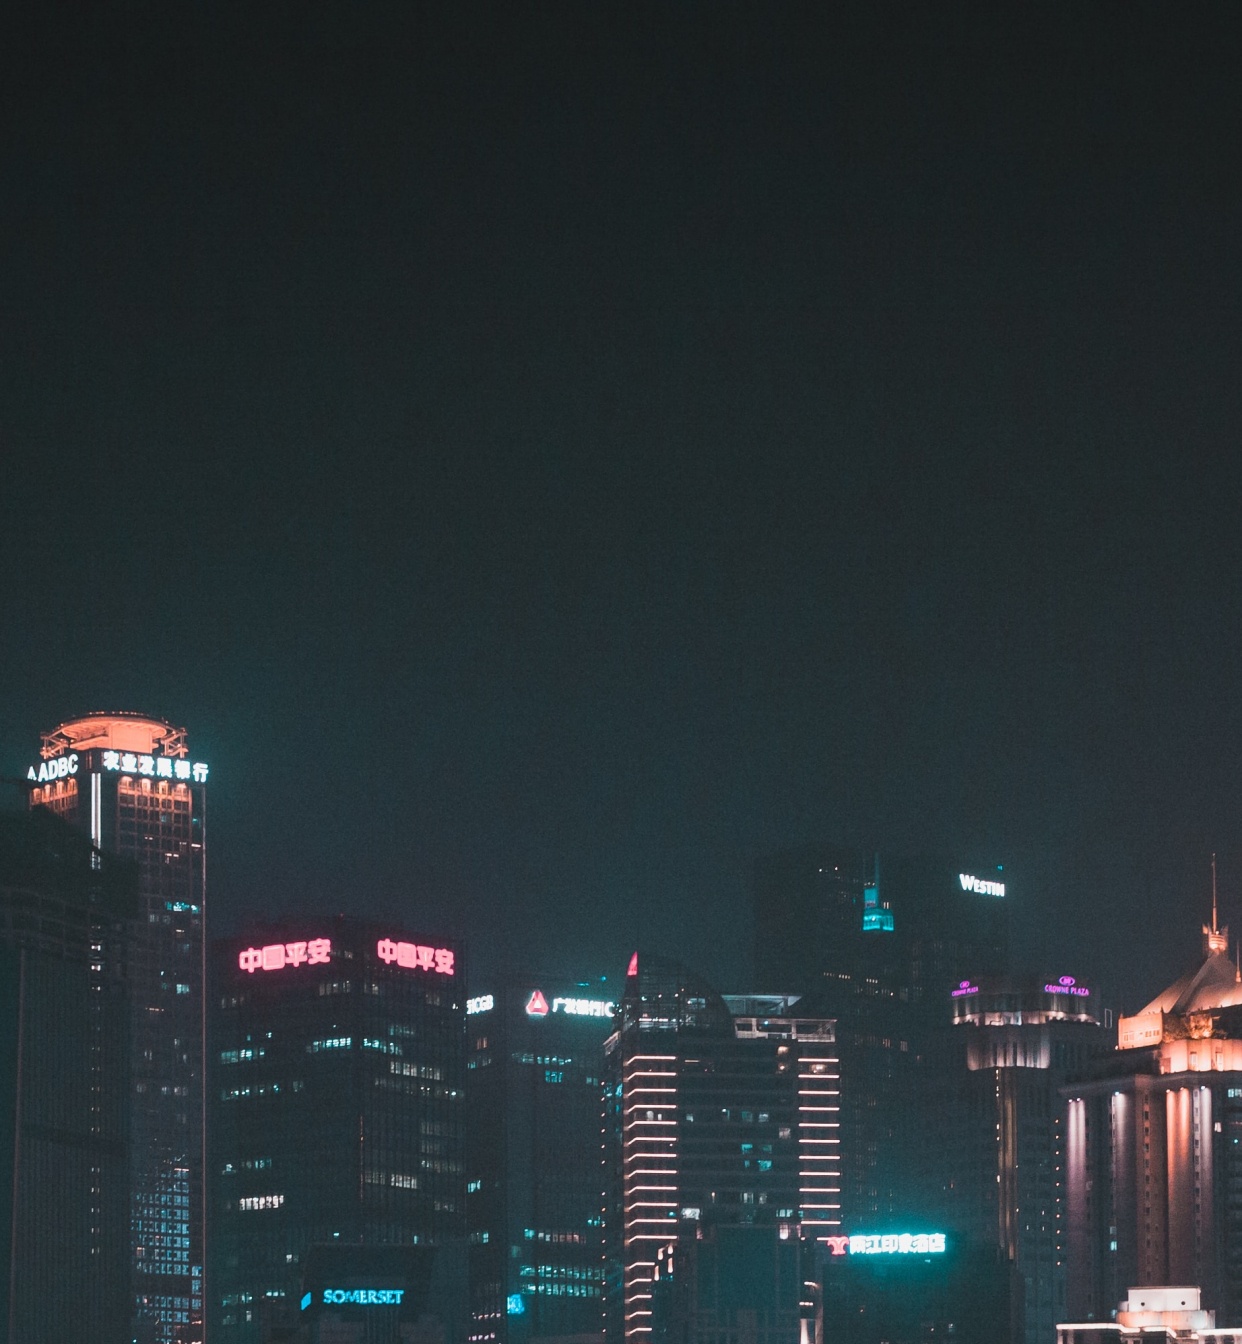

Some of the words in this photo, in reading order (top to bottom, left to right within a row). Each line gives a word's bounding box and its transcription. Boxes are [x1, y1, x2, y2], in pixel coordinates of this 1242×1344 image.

[103, 751, 209, 783] 农业发展银行
[239, 938, 331, 973] 中国平安
[377, 938, 454, 975] 中国平安
[1044, 984, 1069, 994] CROWNE
[1071, 986, 1089, 997] PLAZA
[323, 1289, 404, 1304] SOMERSET
